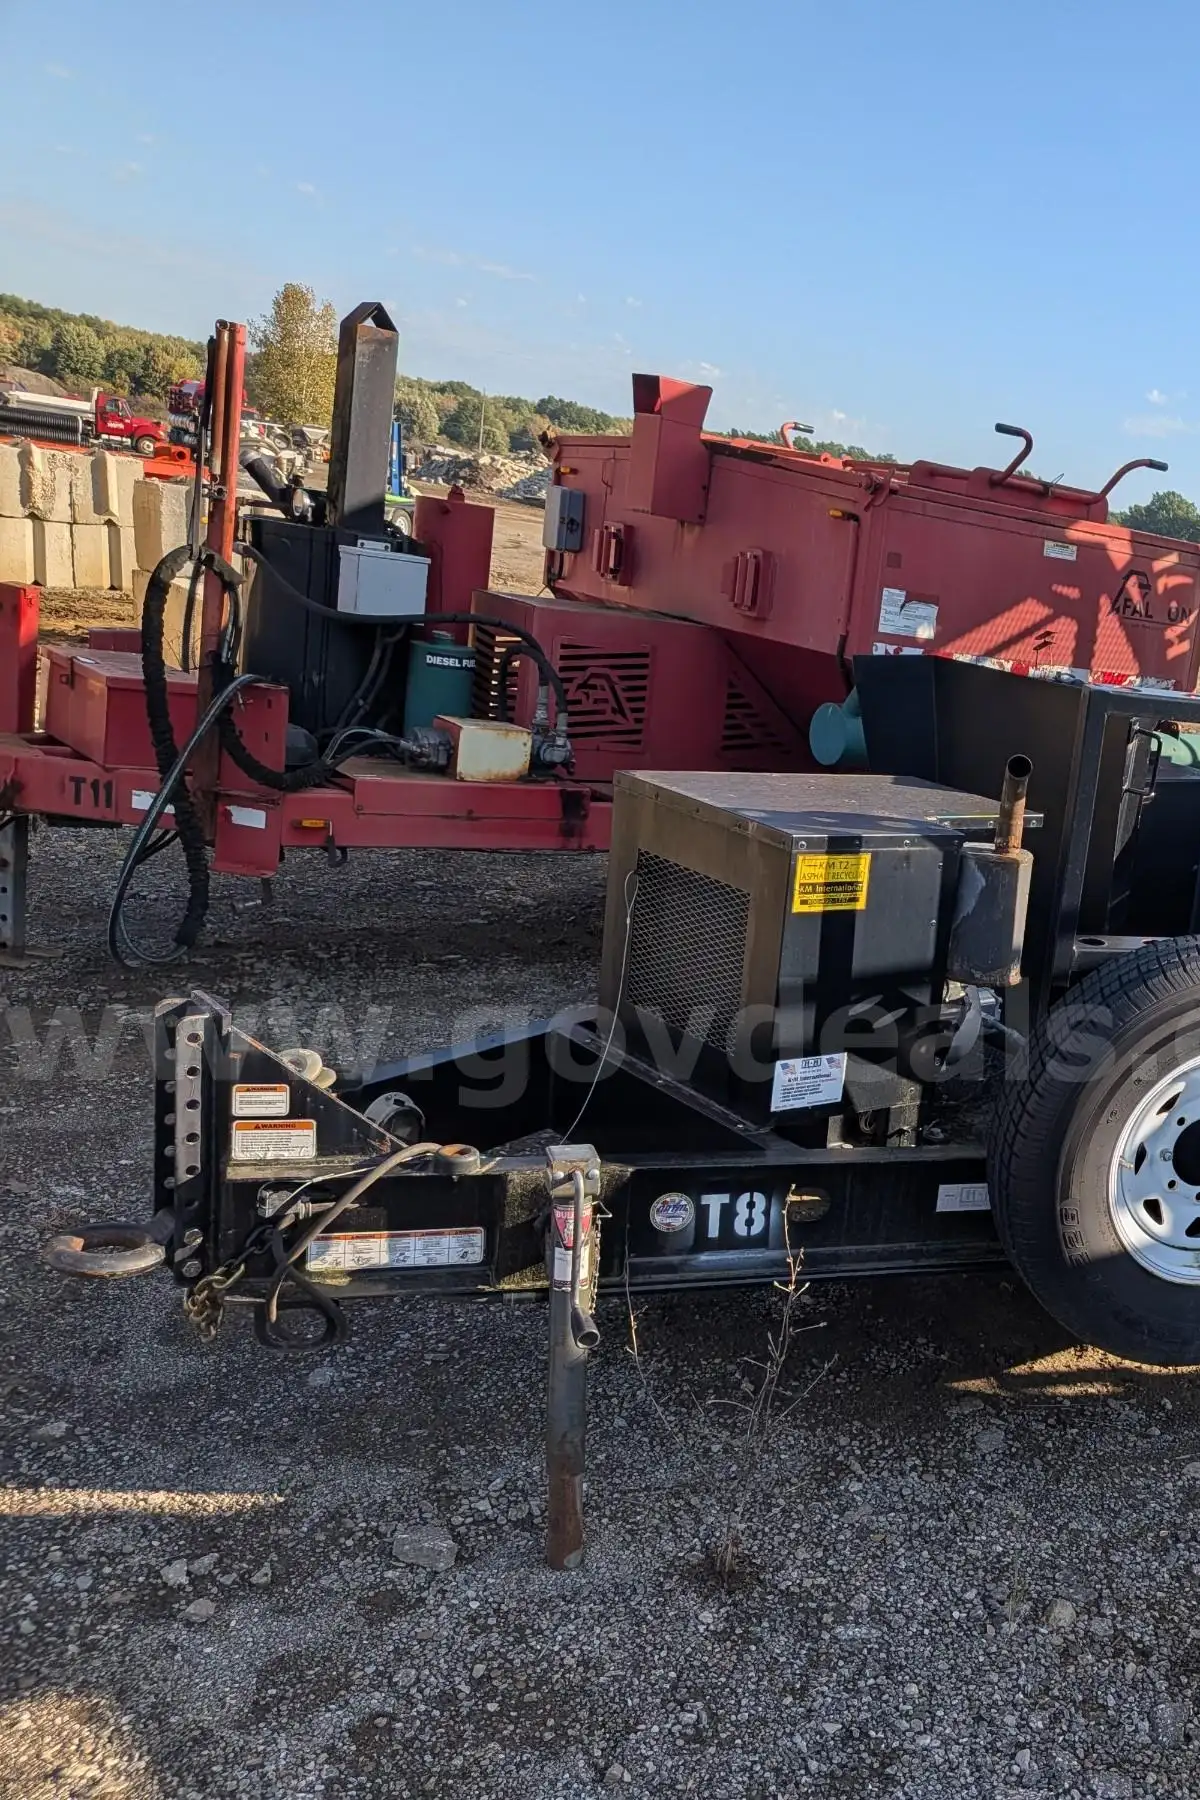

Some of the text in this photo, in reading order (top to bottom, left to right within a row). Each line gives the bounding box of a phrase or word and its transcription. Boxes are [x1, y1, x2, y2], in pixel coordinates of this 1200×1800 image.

[1122, 597, 1193, 622] FALON
[426, 654, 461, 667] DIESEL
[69, 776, 113, 809] T11
[700, 1191, 766, 1238] T8
